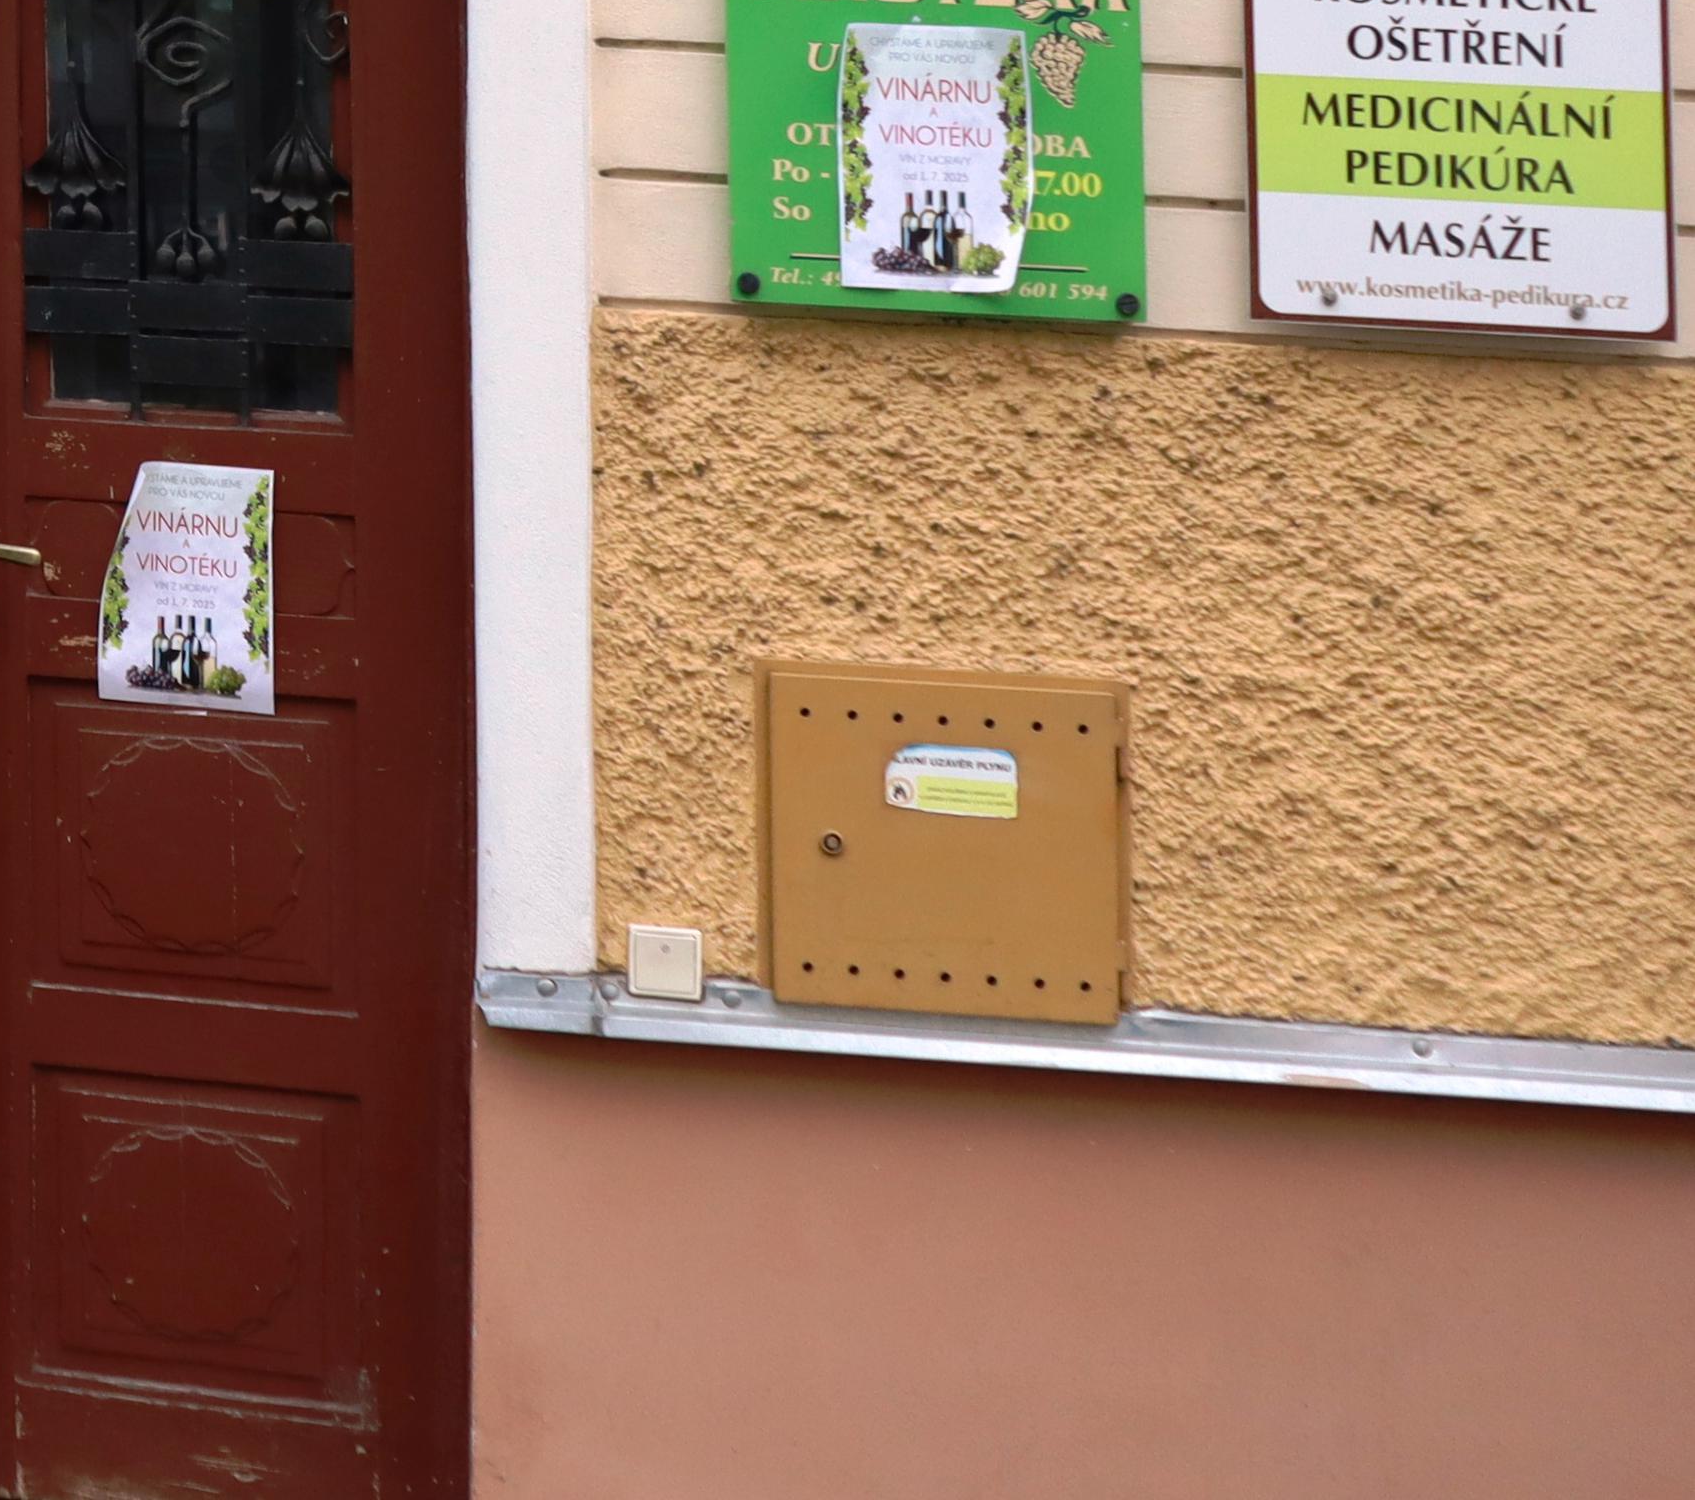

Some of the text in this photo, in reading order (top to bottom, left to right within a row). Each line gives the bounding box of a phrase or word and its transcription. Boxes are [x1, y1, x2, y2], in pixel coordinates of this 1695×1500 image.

[1347, 15, 1568, 68] OŠETŘENÍ
[876, 72, 992, 105] VINÁRNU
[929, 107, 938, 117] A
[1302, 91, 1616, 140] MEDICINÁLNÍ
[878, 121, 993, 149] VINOTÉKU
[772, 158, 810, 183] Po
[902, 171, 918, 181] od
[1345, 146, 1575, 195] PEDIKÚRA
[772, 196, 811, 221] So
[1369, 213, 1552, 263] MASÁŽE
[770, 266, 813, 285] Tel.:
[1019, 283, 1109, 302] 601 594
[1296, 276, 1629, 311] www.kosmetika-pedikura.cz
[136, 507, 238, 539] VINÁRNU
[182, 539, 190, 548] A
[136, 552, 237, 579] VINOTÉKU
